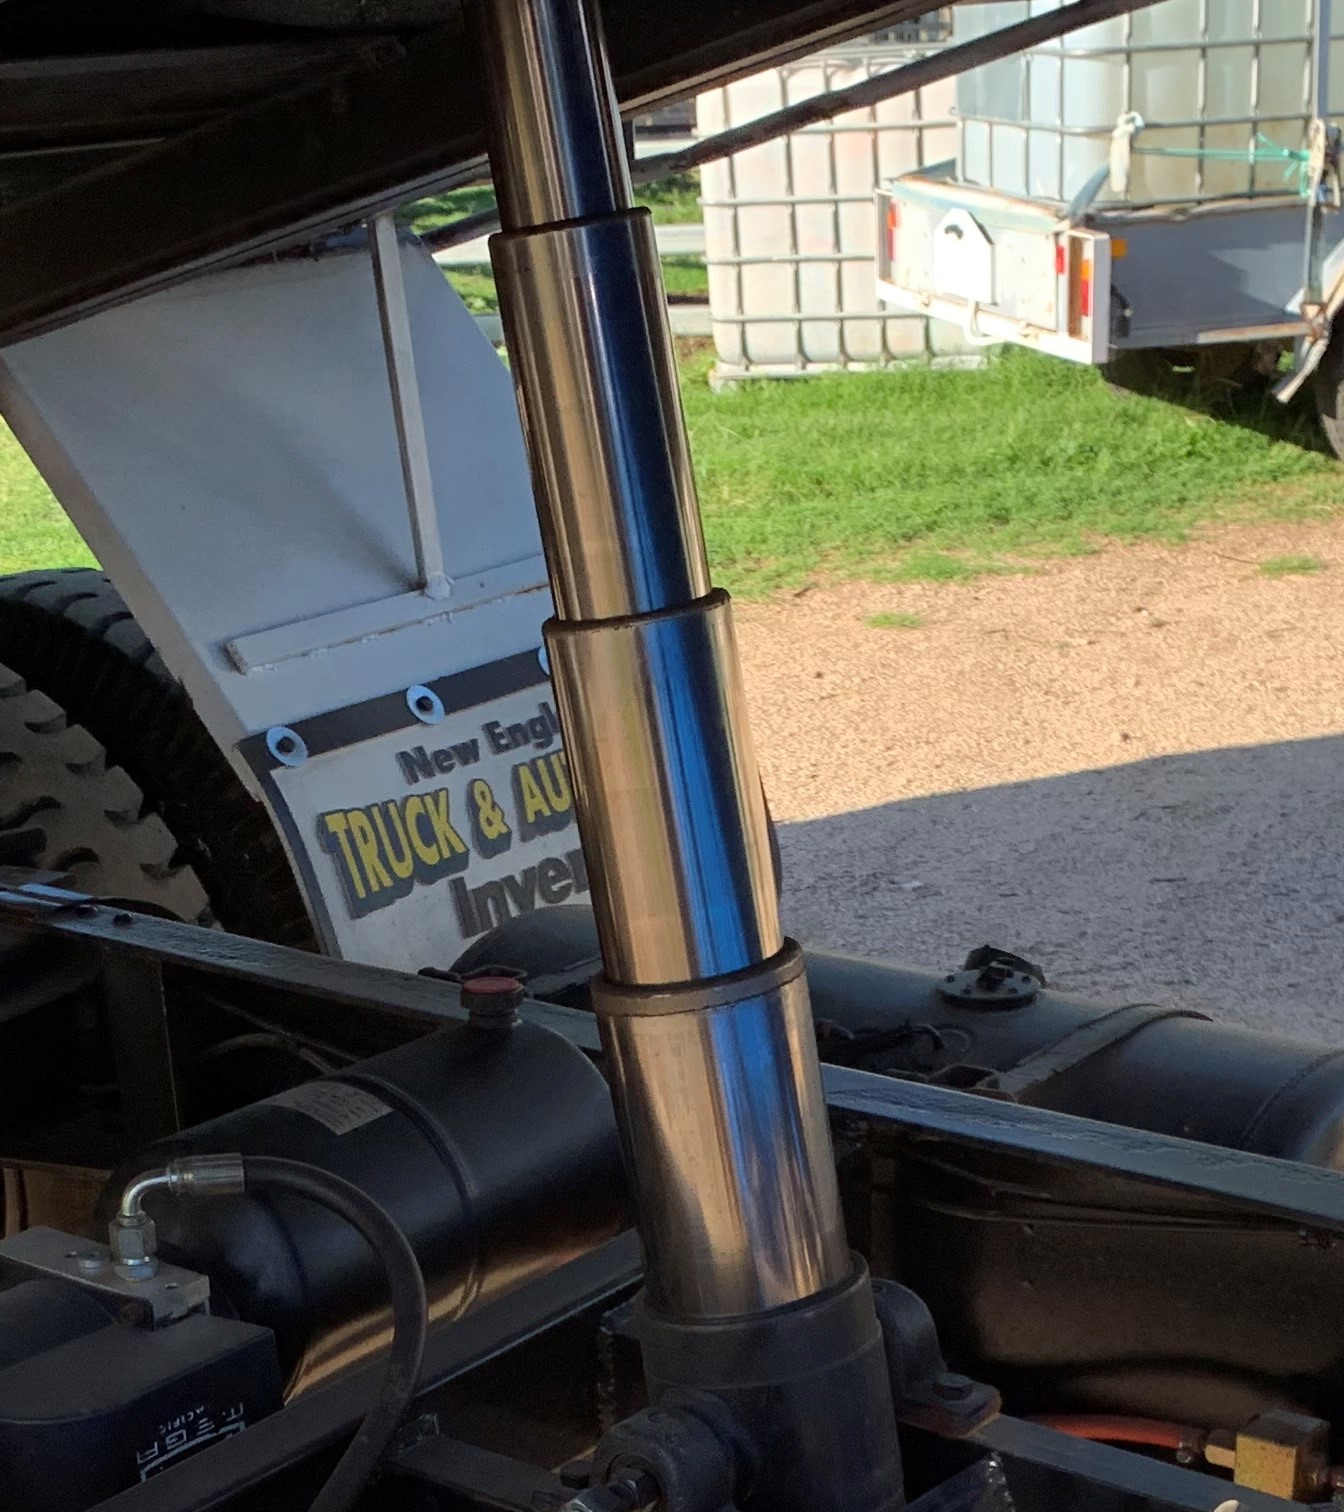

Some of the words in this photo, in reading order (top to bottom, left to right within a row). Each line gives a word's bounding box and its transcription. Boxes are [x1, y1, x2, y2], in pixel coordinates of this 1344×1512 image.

[395, 738, 480, 785] New
[482, 702, 560, 755] Engl
[318, 788, 468, 910] TRUCK
[469, 779, 511, 850] &
[159, 1402, 209, 1434] ACIFIC
